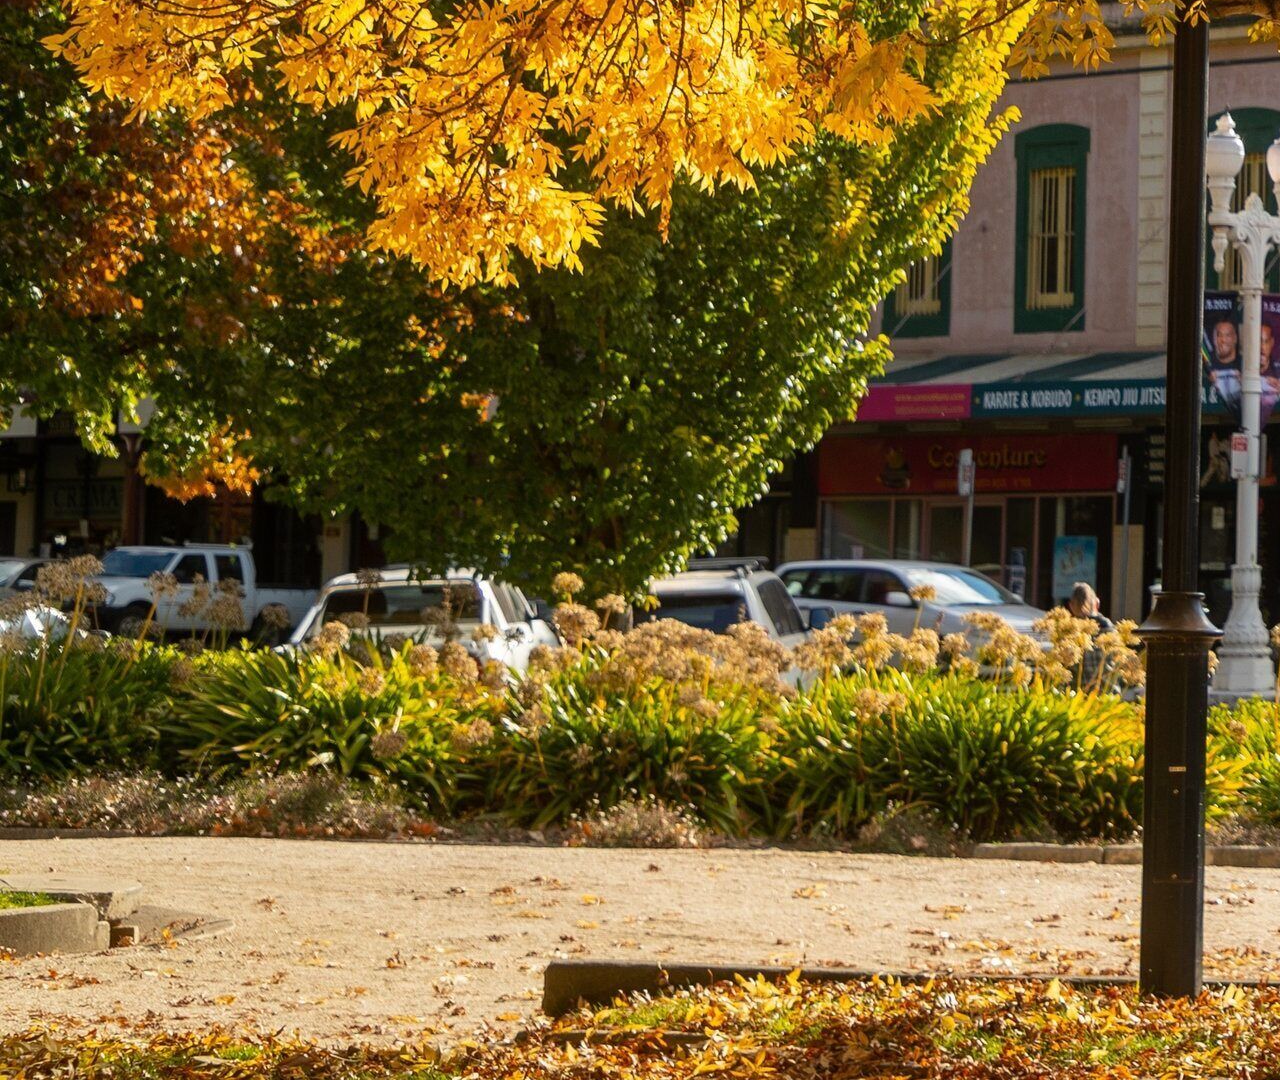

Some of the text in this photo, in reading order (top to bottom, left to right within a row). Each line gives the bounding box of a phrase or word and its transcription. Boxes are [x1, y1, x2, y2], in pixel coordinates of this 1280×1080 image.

[984, 390, 1019, 409] KARATE
[1019, 390, 1029, 408] &
[1031, 389, 1072, 408] KOBUDO
[1084, 387, 1121, 407] KEMPO
[1122, 387, 1138, 406] JIU
[1140, 386, 1167, 406] JITSU
[1209, 385, 1218, 404] &
[928, 443, 1047, 470] Coenture
[54, 486, 118, 507] CRMA
